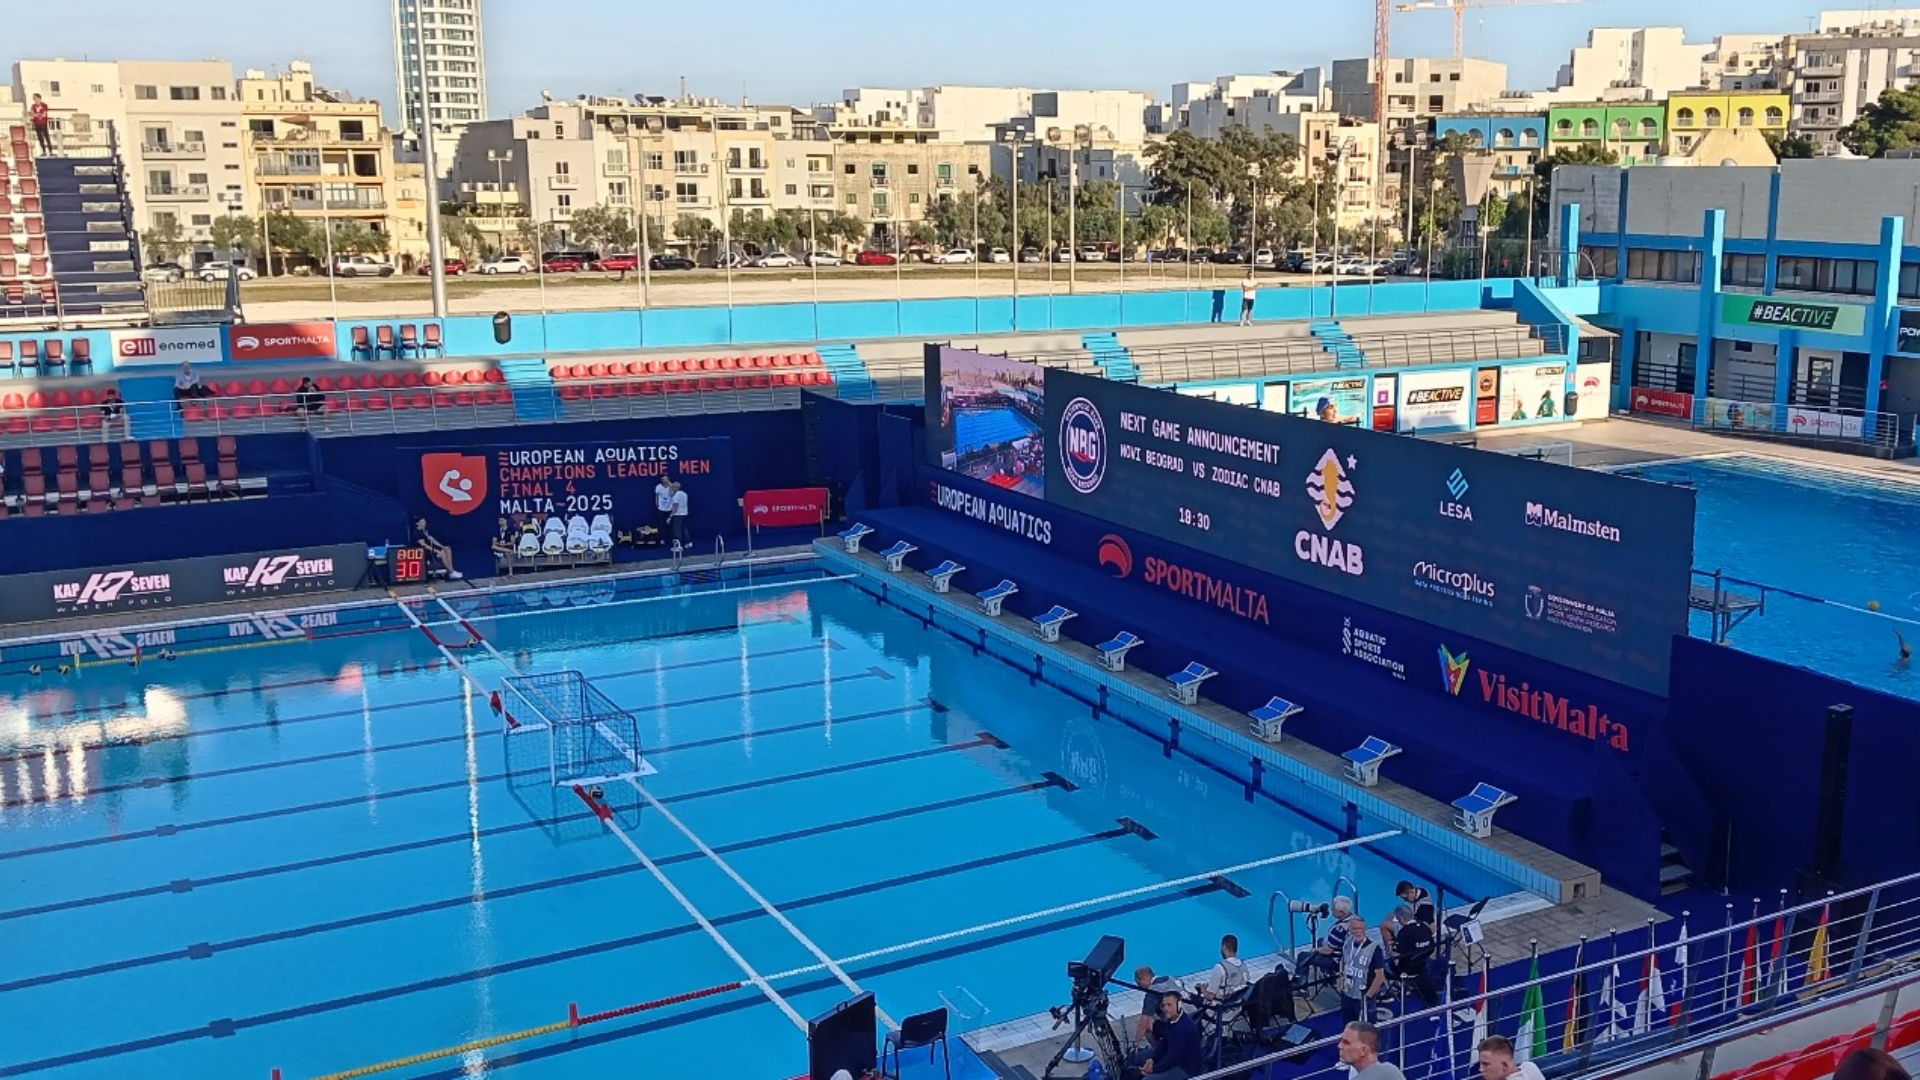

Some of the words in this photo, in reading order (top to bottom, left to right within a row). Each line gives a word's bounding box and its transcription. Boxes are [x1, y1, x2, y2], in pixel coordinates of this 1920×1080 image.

[1753, 303, 1835, 326] #BEACTIVE
[159, 339, 215, 351] enemed
[264, 335, 330, 347] SPORTMALTA
[1410, 388, 1463, 403] #BEACTIVE
[1069, 426, 1096, 460] NRG
[1120, 412, 1147, 434] NEXT
[1152, 419, 1181, 442] GAME
[1187, 427, 1281, 464] ANNOUNCEMENT
[499, 449, 585, 466] EUROPEAN
[500, 464, 596, 482] CHAMPIONS
[607, 461, 668, 479] LEAGUE
[679, 459, 710, 475] MEN
[1120, 444, 1141, 462] NOVI
[1146, 450, 1184, 472] BEOGRAD
[1192, 461, 1205, 478] VS
[1212, 466, 1249, 489] ZODIAC
[1254, 477, 1281, 498] CNAB
[500, 482, 554, 498] FINAL
[565, 480, 576, 495] 4
[1440, 500, 1473, 522] LESA
[1543, 508, 1620, 542] Malmsten
[1294, 530, 1364, 576] CNAB
[223, 566, 249, 582] KAP
[296, 558, 333, 575] SEVEN
[396, 561, 420, 578] 30
[1413, 561, 1495, 599] Microplus
[53, 582, 80, 599] KAP
[130, 574, 171, 592] SEVEN
[227, 586, 280, 596] WATER
[294, 579, 335, 589] POLO
[1144, 556, 1270, 625] SPORTMALTA
[56, 602, 114, 613] WATER
[128, 596, 172, 605] POLO
[1353, 628, 1387, 646] AQUATIC
[1354, 638, 1381, 655] SPORTS
[1353, 648, 1405, 673] ASSOCIATION
[1477, 668, 1629, 752] VisitMalta
[1272, 724, 1279, 735] 2
[1482, 816, 1489, 829] 0
